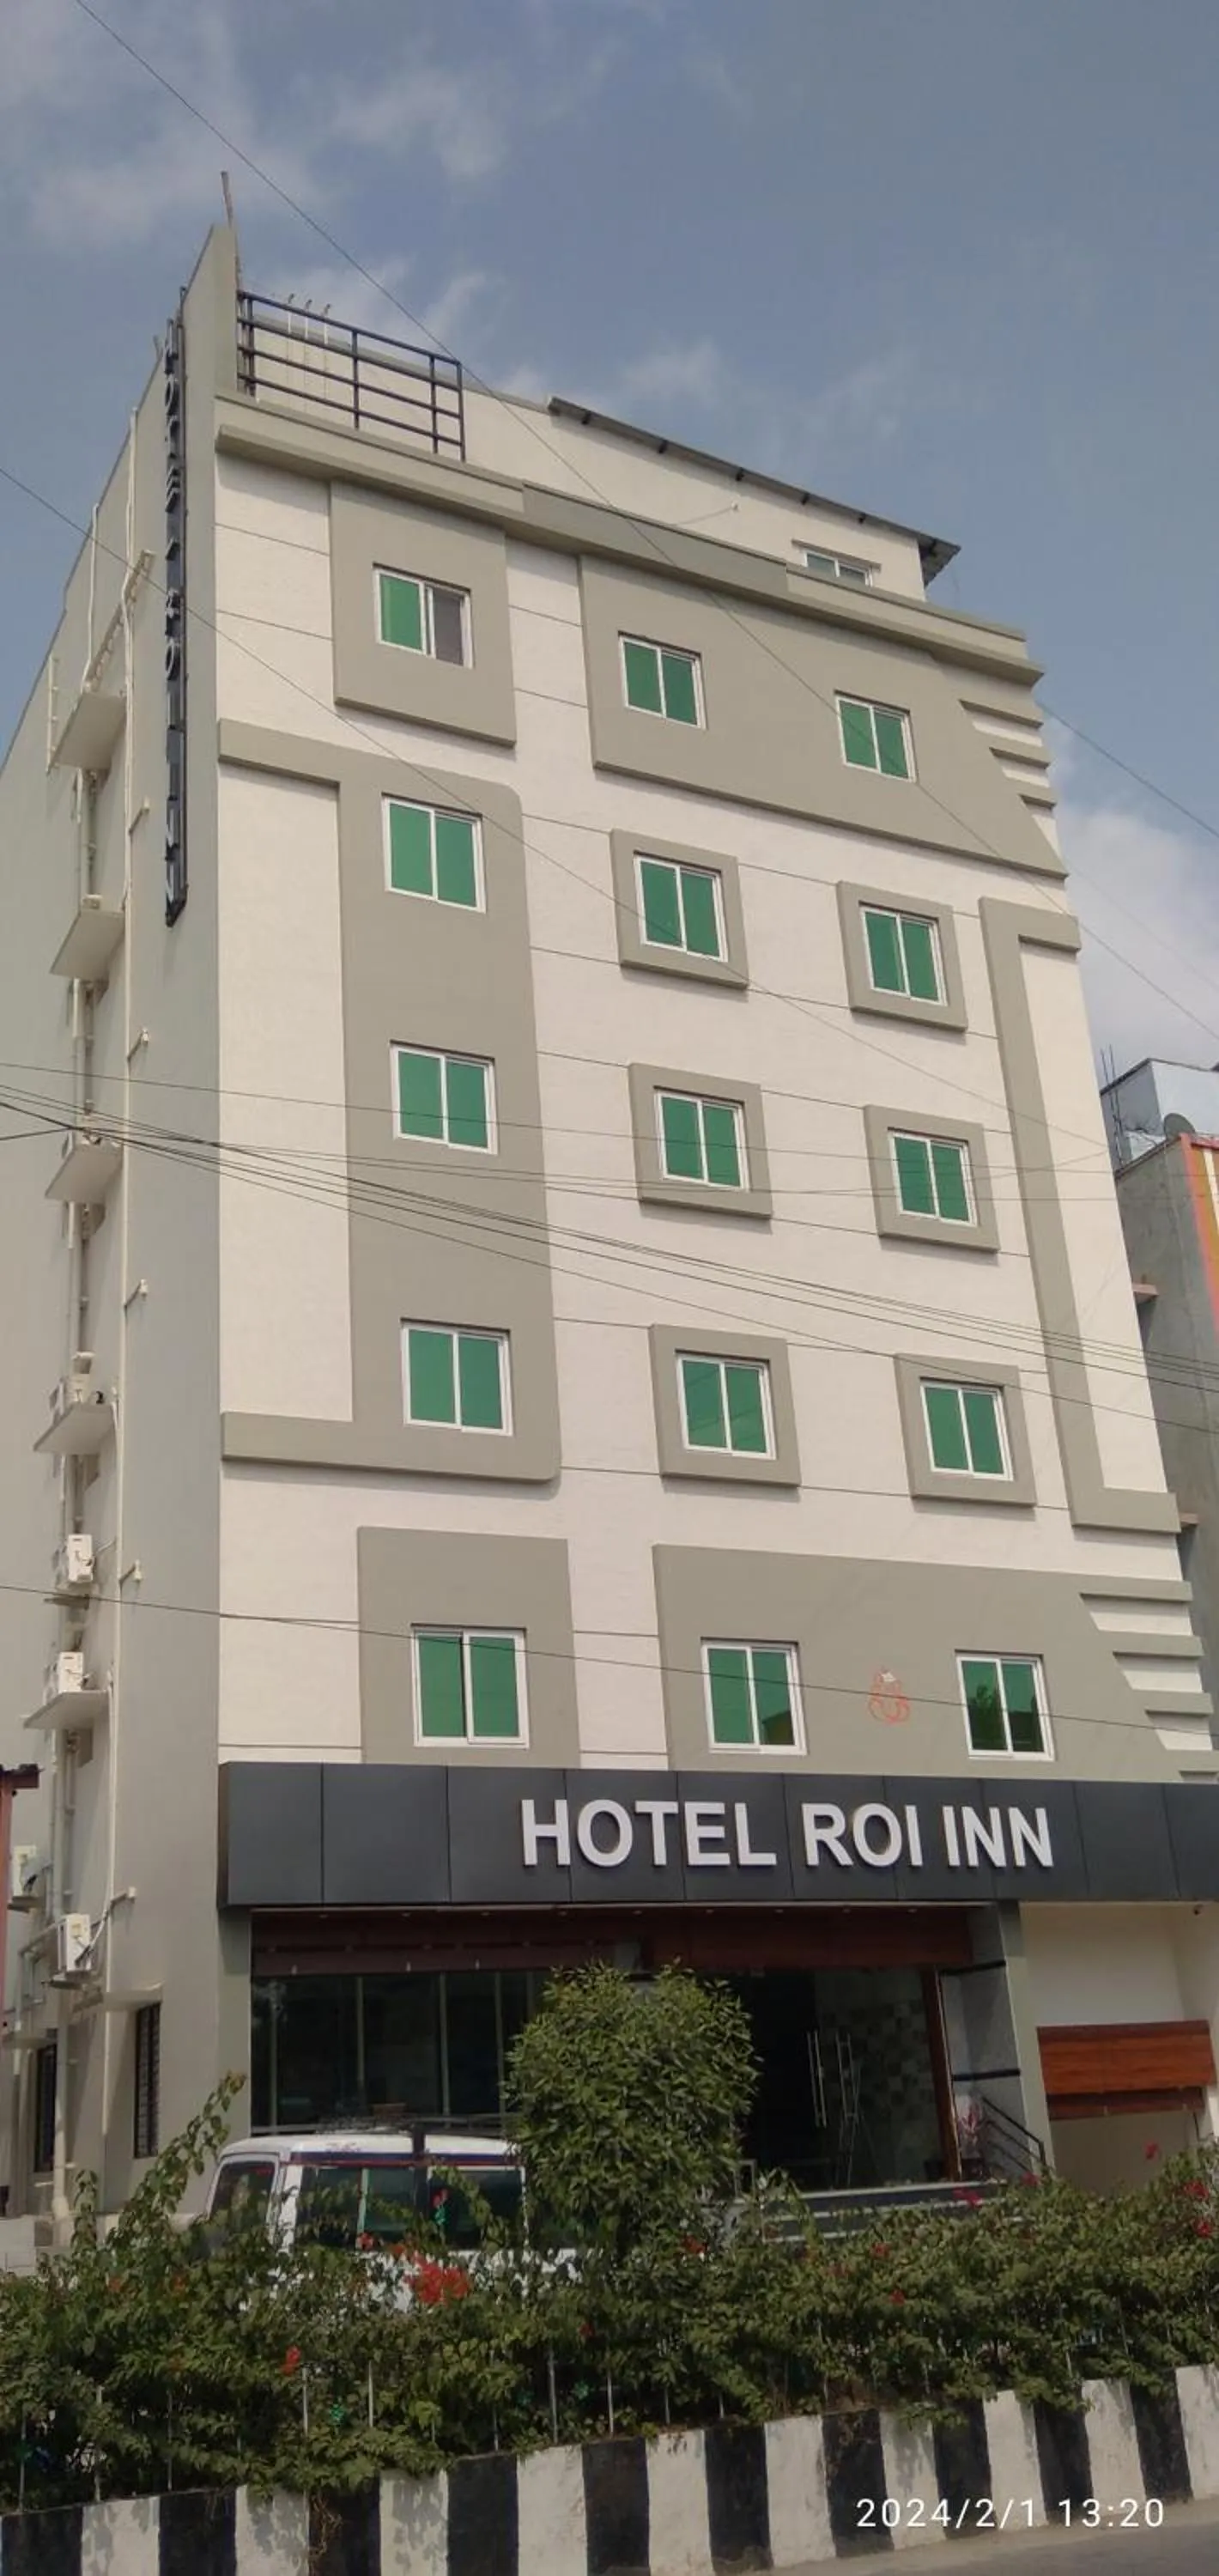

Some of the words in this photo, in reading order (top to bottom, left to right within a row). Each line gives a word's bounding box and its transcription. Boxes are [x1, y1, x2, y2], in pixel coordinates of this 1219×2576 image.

[520, 1798, 777, 1867] HOTEL
[802, 1802, 924, 1867] ROI
[942, 1805, 1054, 1868] INN
